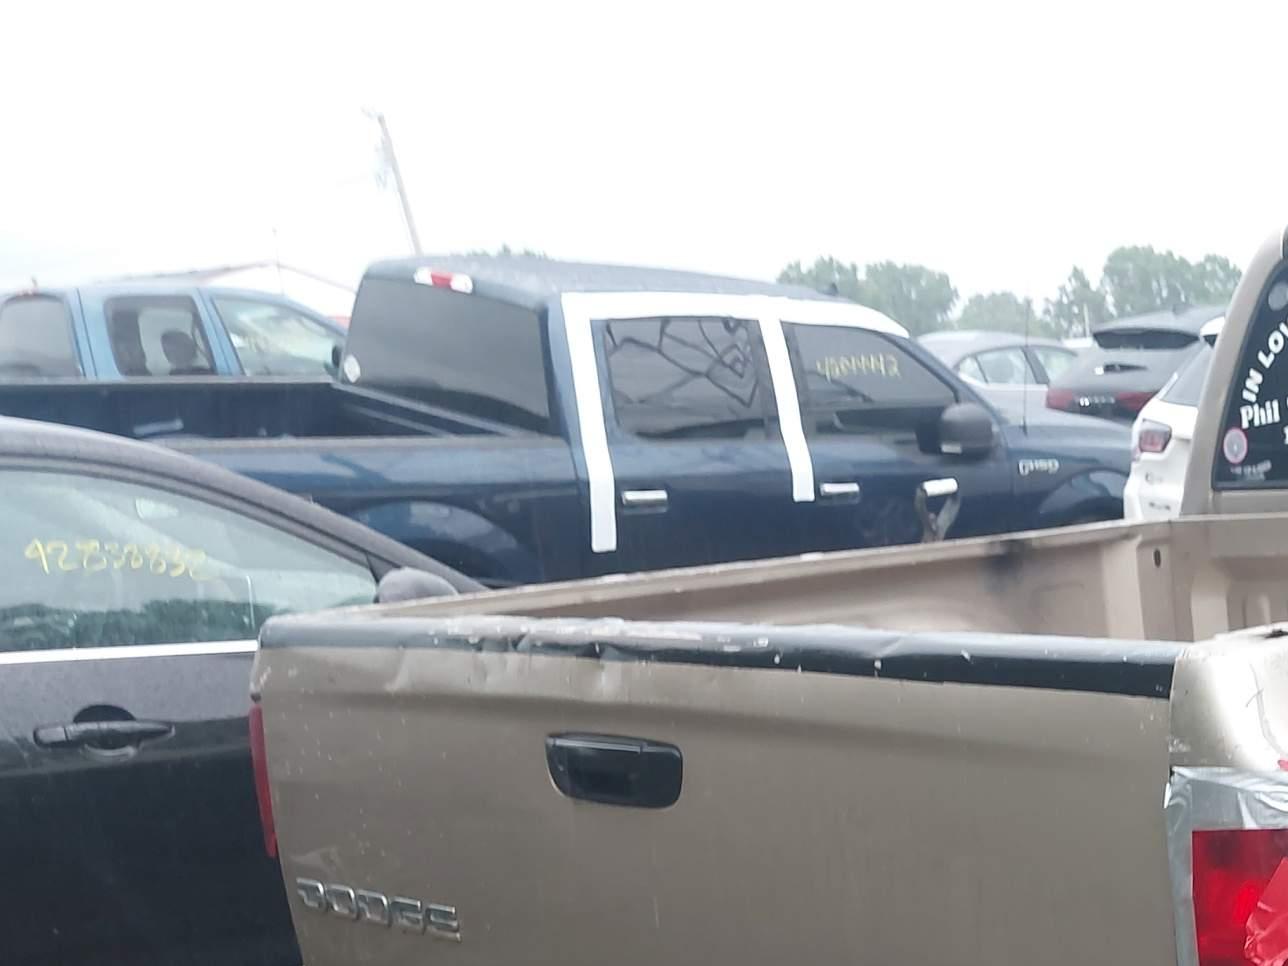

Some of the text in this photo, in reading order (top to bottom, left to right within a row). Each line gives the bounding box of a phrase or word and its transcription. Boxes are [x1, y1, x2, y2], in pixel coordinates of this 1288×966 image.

[1242, 369, 1264, 402] IN
[1240, 400, 1281, 430] Phil
[296, 877, 462, 943] DODGE
